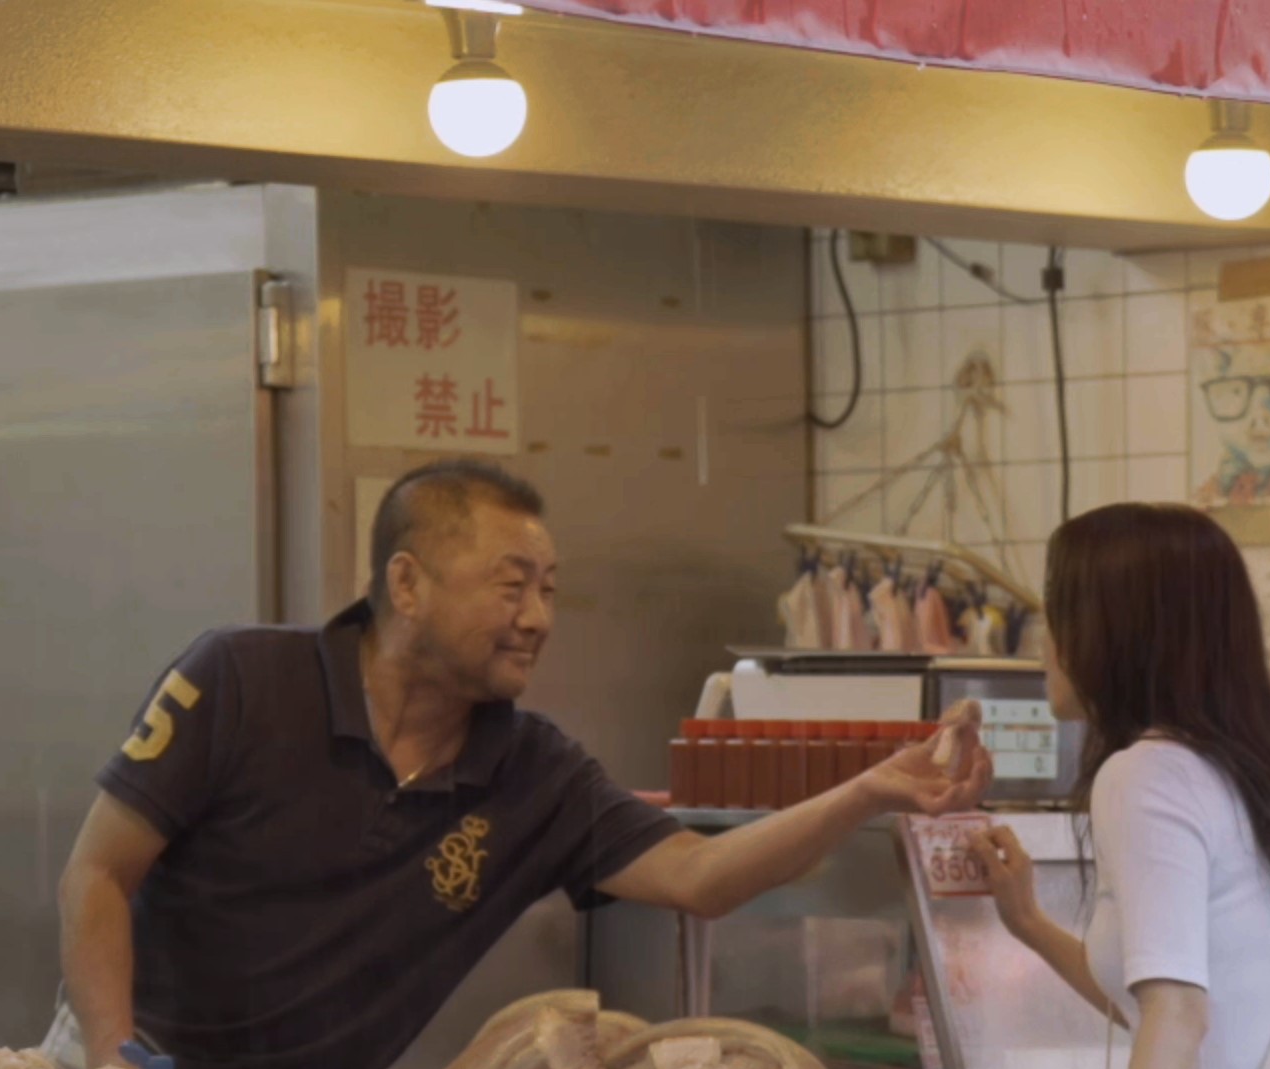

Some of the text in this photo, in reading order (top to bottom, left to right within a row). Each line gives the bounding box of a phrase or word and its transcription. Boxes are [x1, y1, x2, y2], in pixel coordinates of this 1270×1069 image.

[362, 279, 461, 349] 撮影
[414, 374, 510, 439] 禁止
[121, 669, 200, 762] 5
